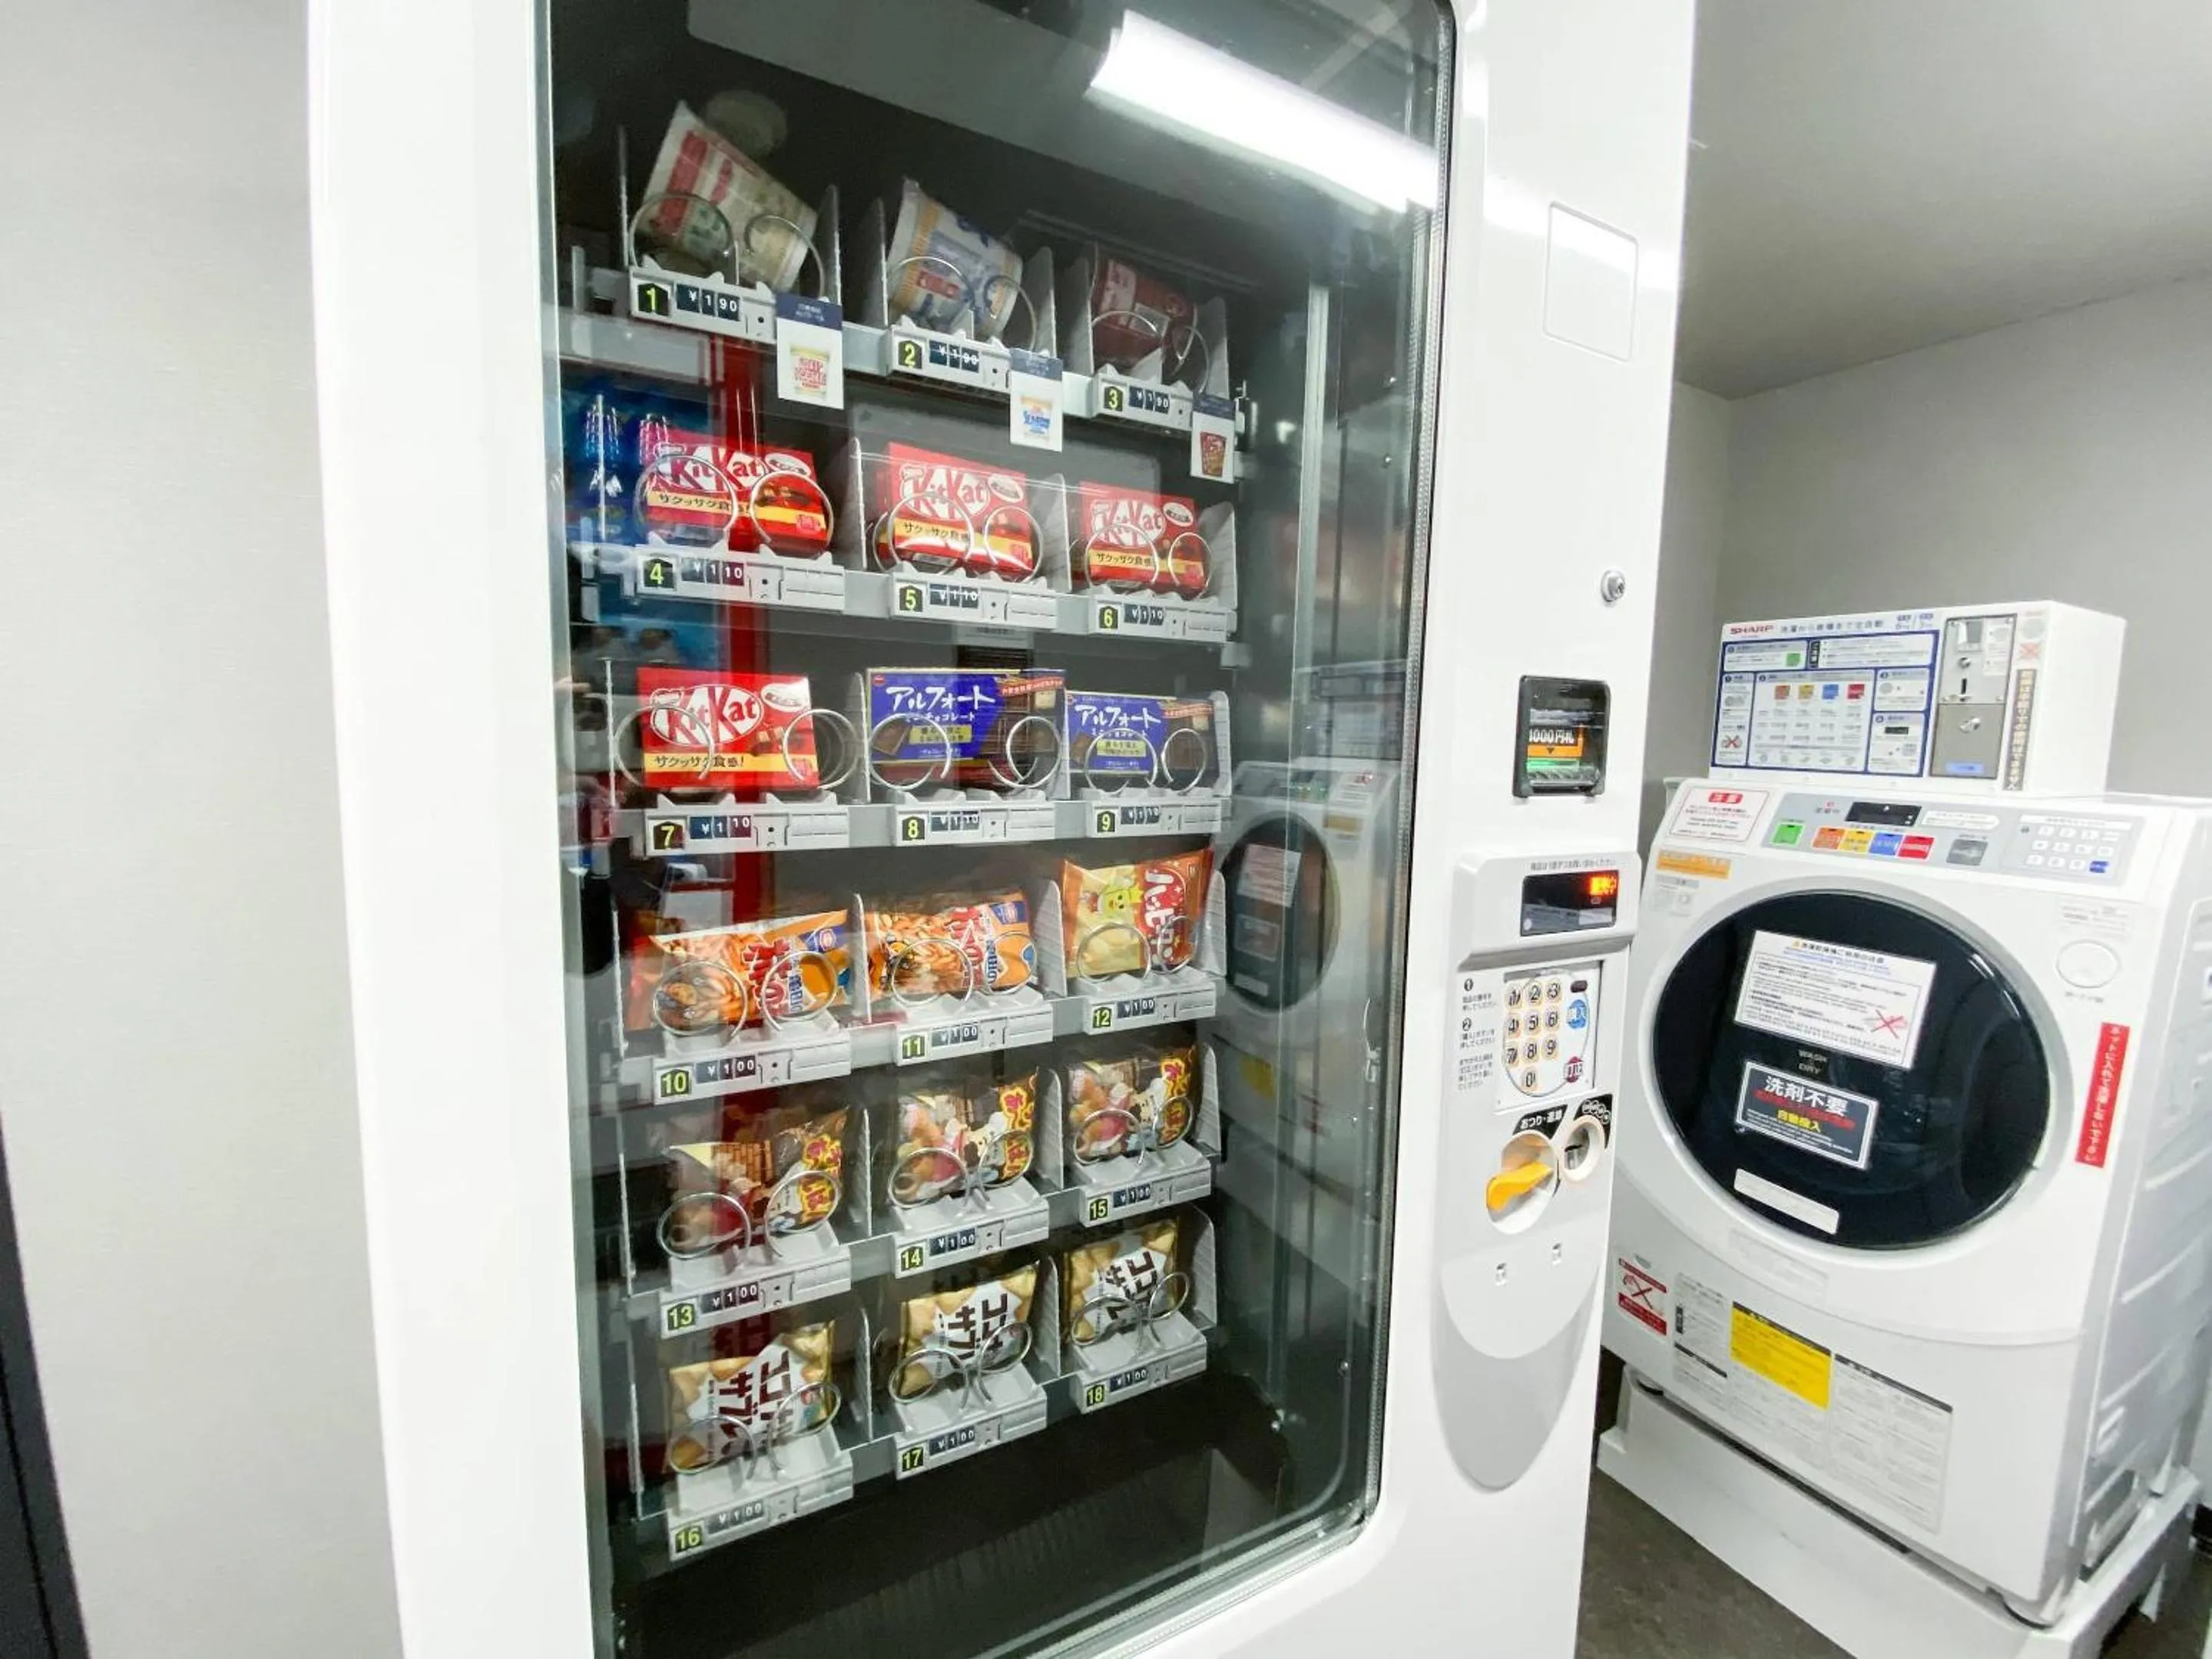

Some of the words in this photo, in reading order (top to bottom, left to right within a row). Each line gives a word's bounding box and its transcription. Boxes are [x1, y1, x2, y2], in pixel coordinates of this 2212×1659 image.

[646, 287, 657, 312] 1
[687, 290, 738, 313] ¥190
[903, 344, 916, 369] 2
[1108, 389, 1118, 410] 3
[668, 445, 762, 492] KitKat
[909, 465, 987, 519] KitKat
[1101, 500, 1164, 547] KitKat
[650, 561, 664, 585] 4
[693, 563, 743, 580] ¥110
[905, 591, 916, 611] 5
[1104, 610, 1114, 628] 6
[886, 684, 996, 711] アルフォート
[665, 685, 758, 744] KitKat
[1075, 704, 1162, 729] アルフォート
[661, 825, 675, 849] 7
[700, 817, 750, 834] ¥110
[907, 819, 920, 839] 8
[1101, 812, 1111, 831] 9
[1093, 1009, 1111, 1028] 12
[903, 1038, 922, 1058] 11
[662, 1073, 688, 1094] 10
[707, 1059, 755, 1076] ¥100
[1764, 1075, 1849, 1117] 洗剤不要
[1091, 1201, 1107, 1219] 15
[901, 1251, 921, 1270] 14
[938, 1233, 975, 1250] ¥100
[668, 1306, 693, 1328] 13
[712, 1283, 757, 1308] ¥100
[1087, 1386, 1103, 1406] 18
[1115, 1369, 1147, 1387] ¥100
[902, 1452, 922, 1470] 17
[937, 1429, 975, 1449] ¥100
[675, 1529, 700, 1551] 16
[718, 1502, 763, 1525] ¥100
